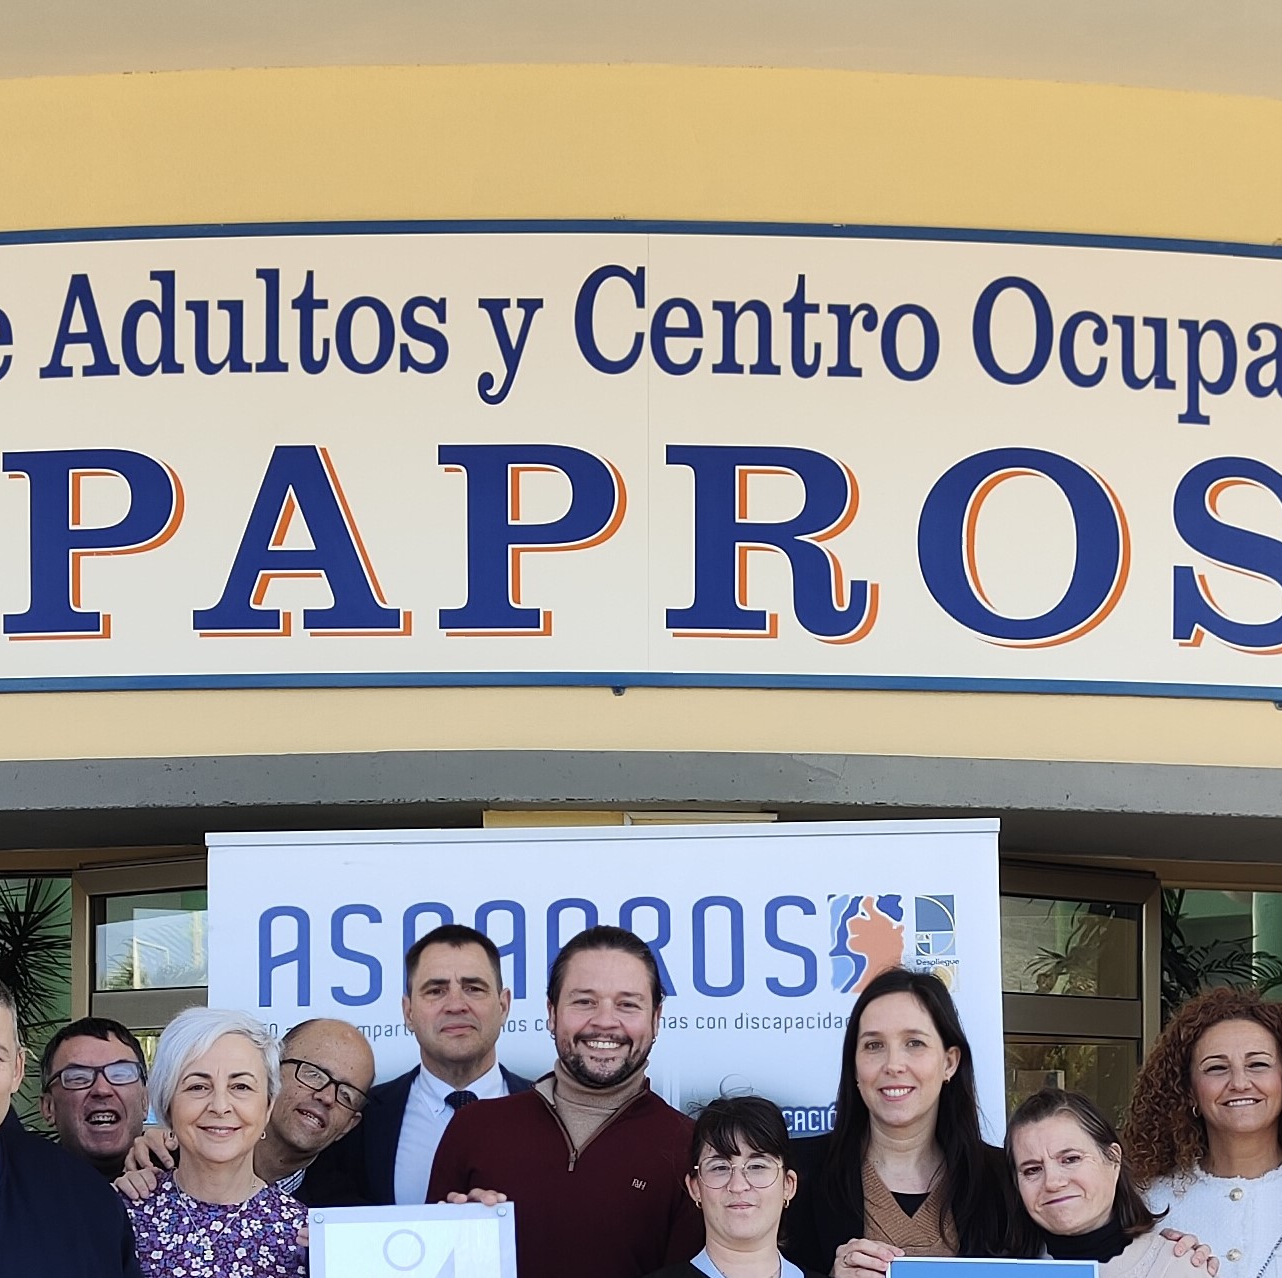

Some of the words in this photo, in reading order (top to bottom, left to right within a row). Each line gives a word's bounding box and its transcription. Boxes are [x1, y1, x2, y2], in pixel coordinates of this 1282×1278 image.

[40, 269, 449, 378] Adultos
[478, 299, 542, 405] y
[575, 266, 939, 381] Centro
[695, 1016, 727, 1030] con
